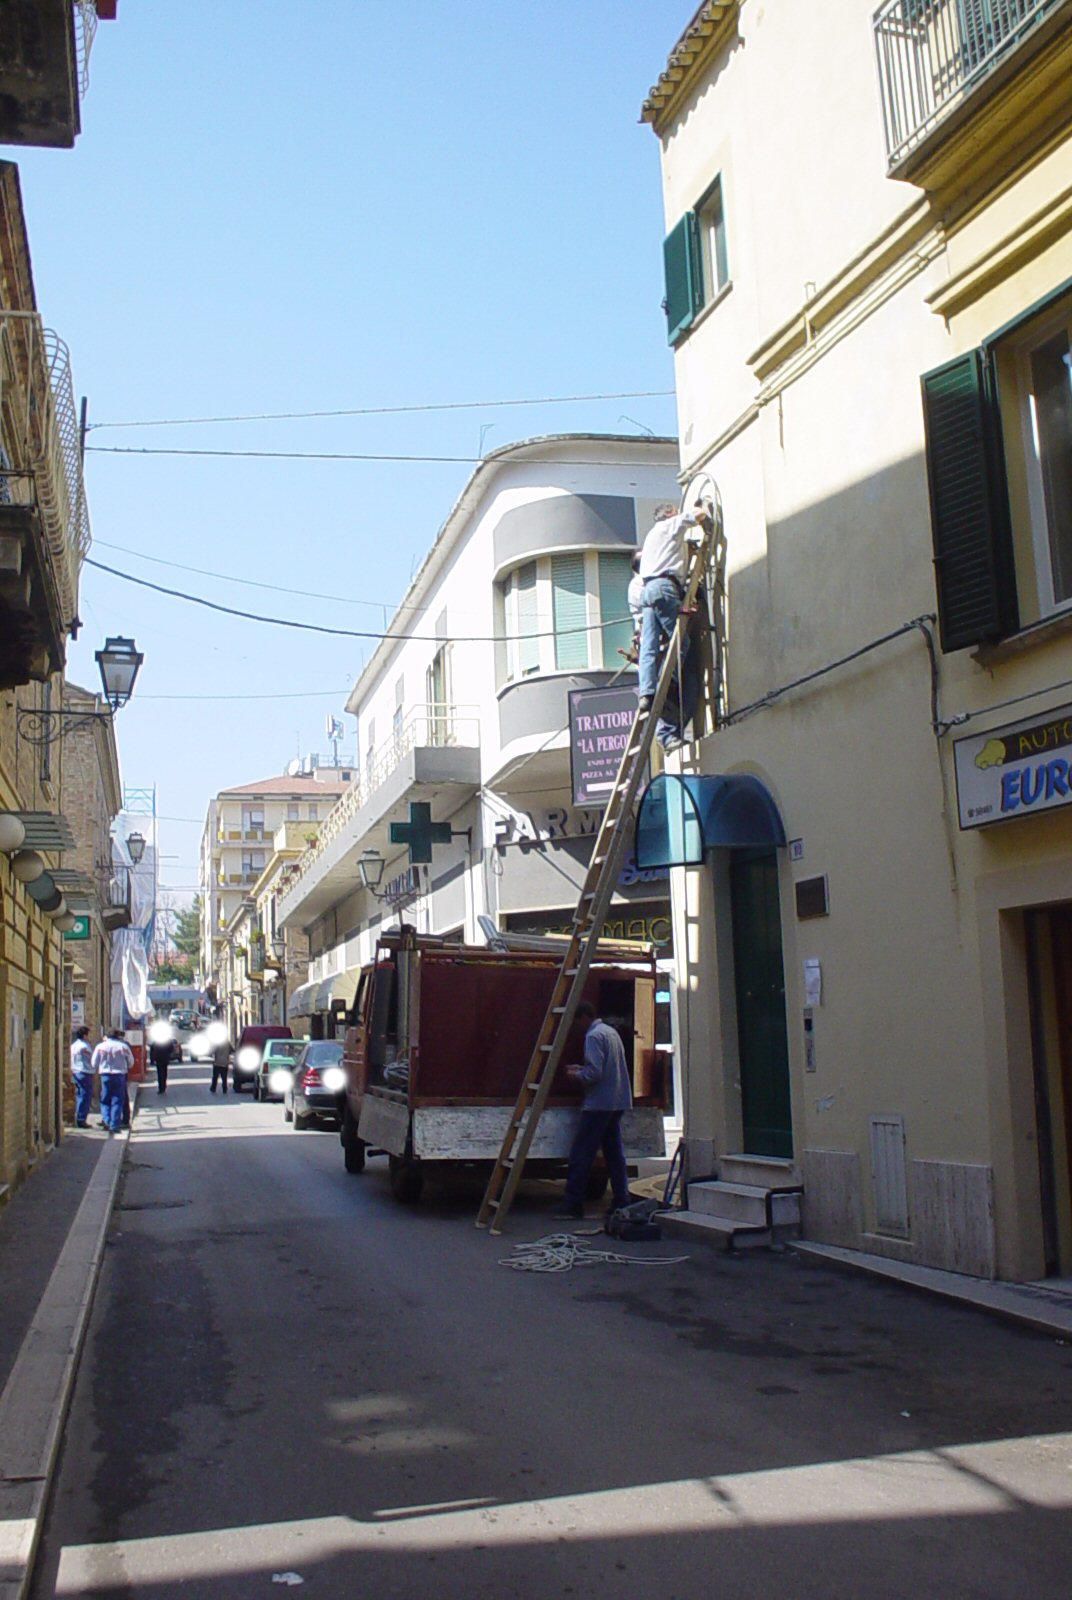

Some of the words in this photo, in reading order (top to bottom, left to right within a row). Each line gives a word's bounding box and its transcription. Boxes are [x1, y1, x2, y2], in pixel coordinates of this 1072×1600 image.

[576, 710, 638, 732] TRATTORI
[596, 734, 631, 753] PERGO
[1001, 758, 1072, 812] EUR
[494, 808, 606, 845] FARM
